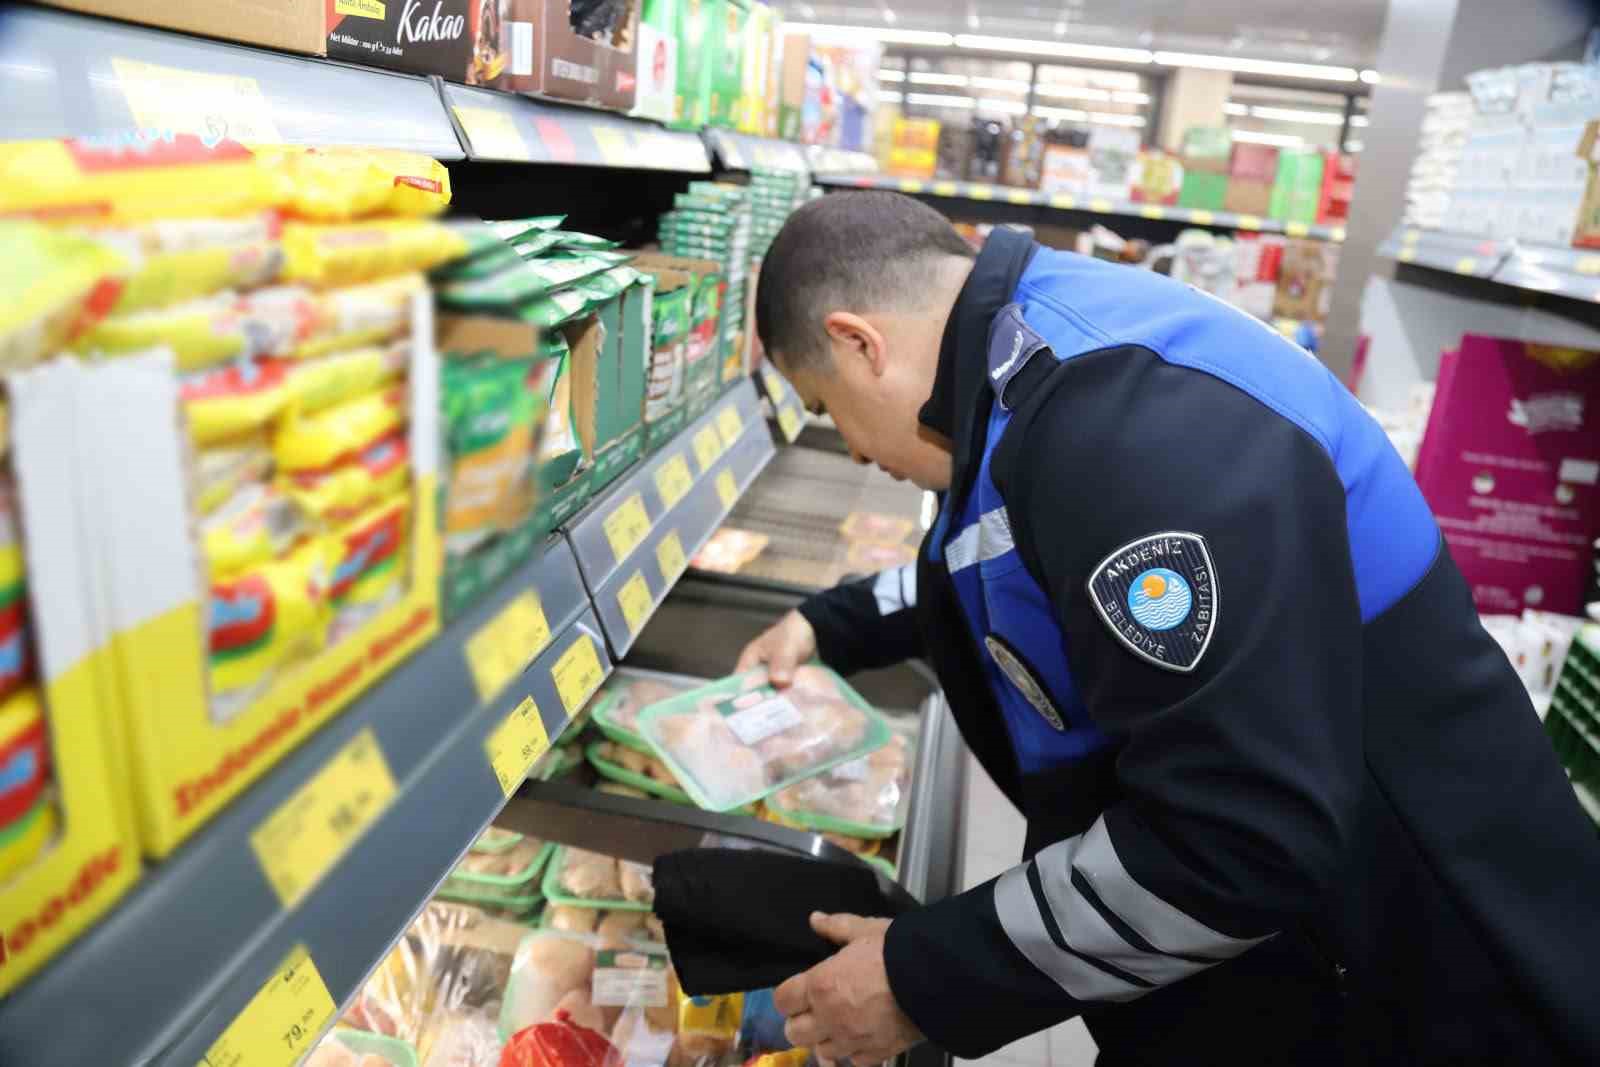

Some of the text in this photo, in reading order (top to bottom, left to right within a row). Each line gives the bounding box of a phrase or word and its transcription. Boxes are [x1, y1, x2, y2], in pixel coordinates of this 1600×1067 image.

[396, 0, 465, 43] Kakao
[1106, 538, 1182, 581] AKDENİZ
[1105, 600, 1166, 658] BELEDİYE
